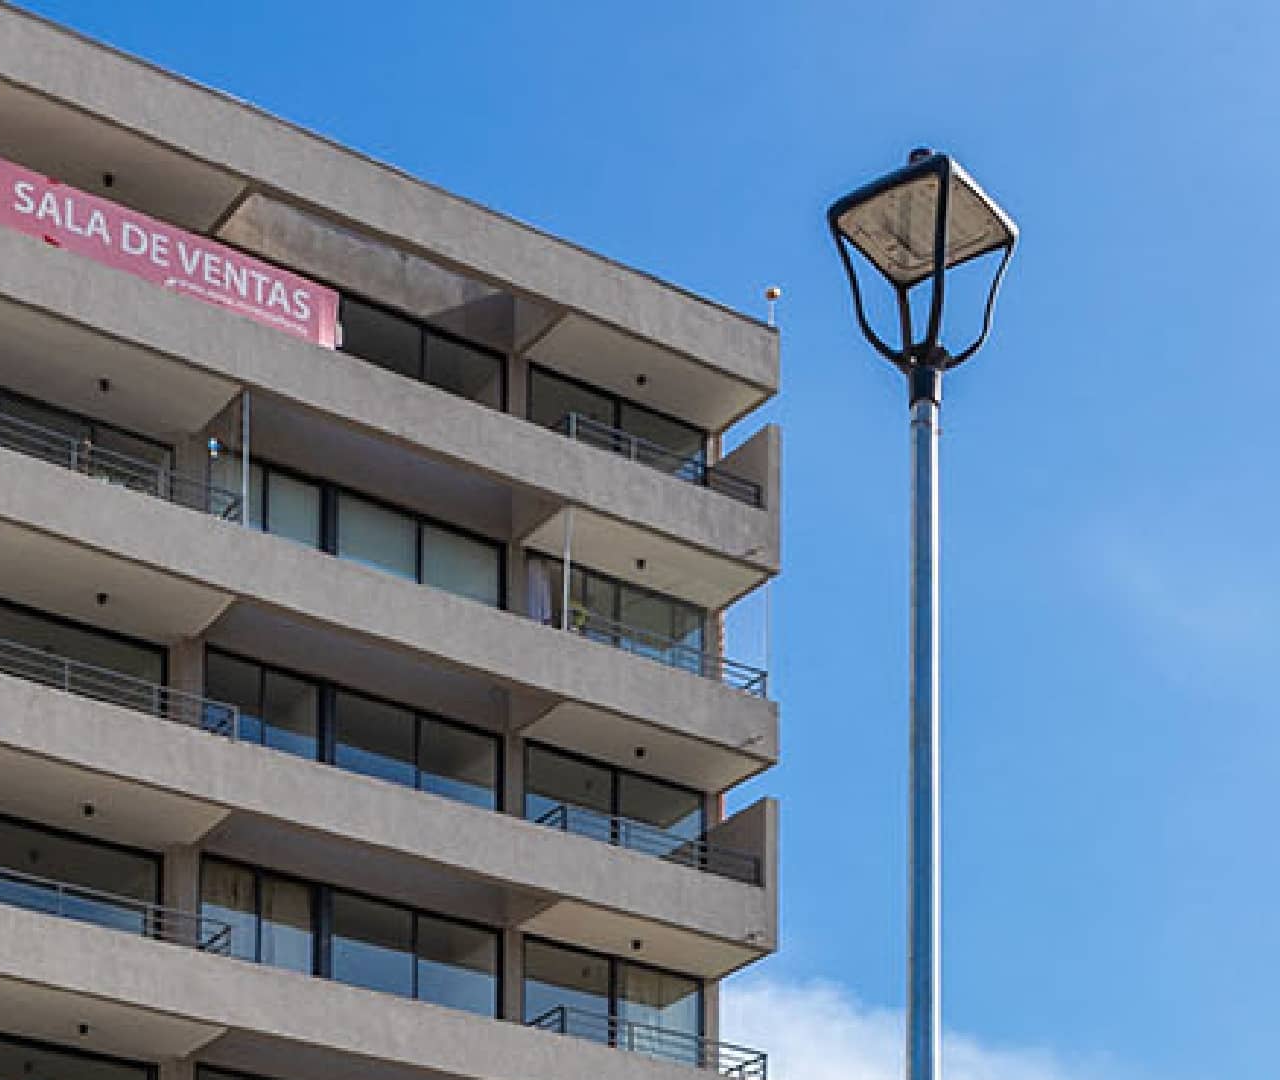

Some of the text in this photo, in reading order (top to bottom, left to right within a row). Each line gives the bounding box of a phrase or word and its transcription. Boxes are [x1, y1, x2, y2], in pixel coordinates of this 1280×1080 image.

[14, 181, 111, 243] SALA
[122, 221, 169, 266] DE
[178, 241, 310, 321] VENTAS
